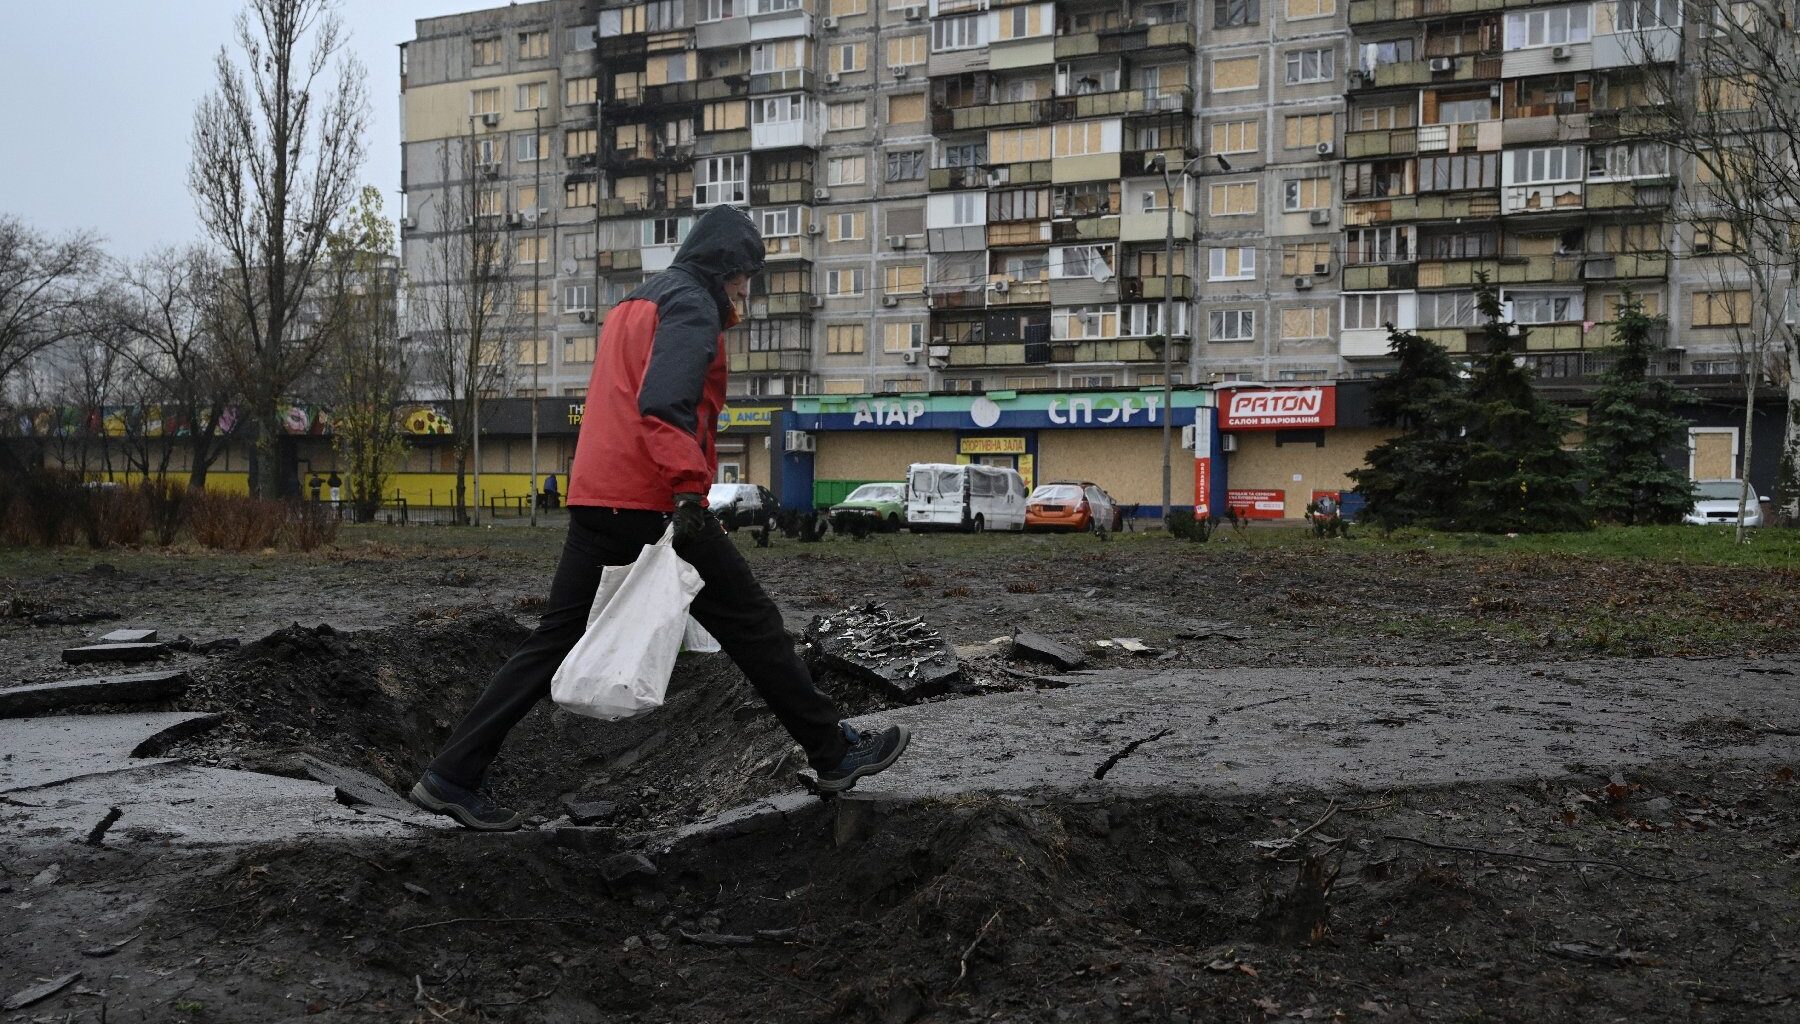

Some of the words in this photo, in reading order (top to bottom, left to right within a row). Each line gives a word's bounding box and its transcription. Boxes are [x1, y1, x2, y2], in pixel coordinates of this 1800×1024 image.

[853, 400, 925, 426] АТАР
[1048, 396, 1159, 424] СПОРТ
[1235, 395, 1317, 413] PATON
[1260, 416, 1320, 425] ЗВАРЮВАННЯ
[962, 440, 1002, 451] СПОРТИВНА
[1004, 440, 1024, 451] ЗАЛА
